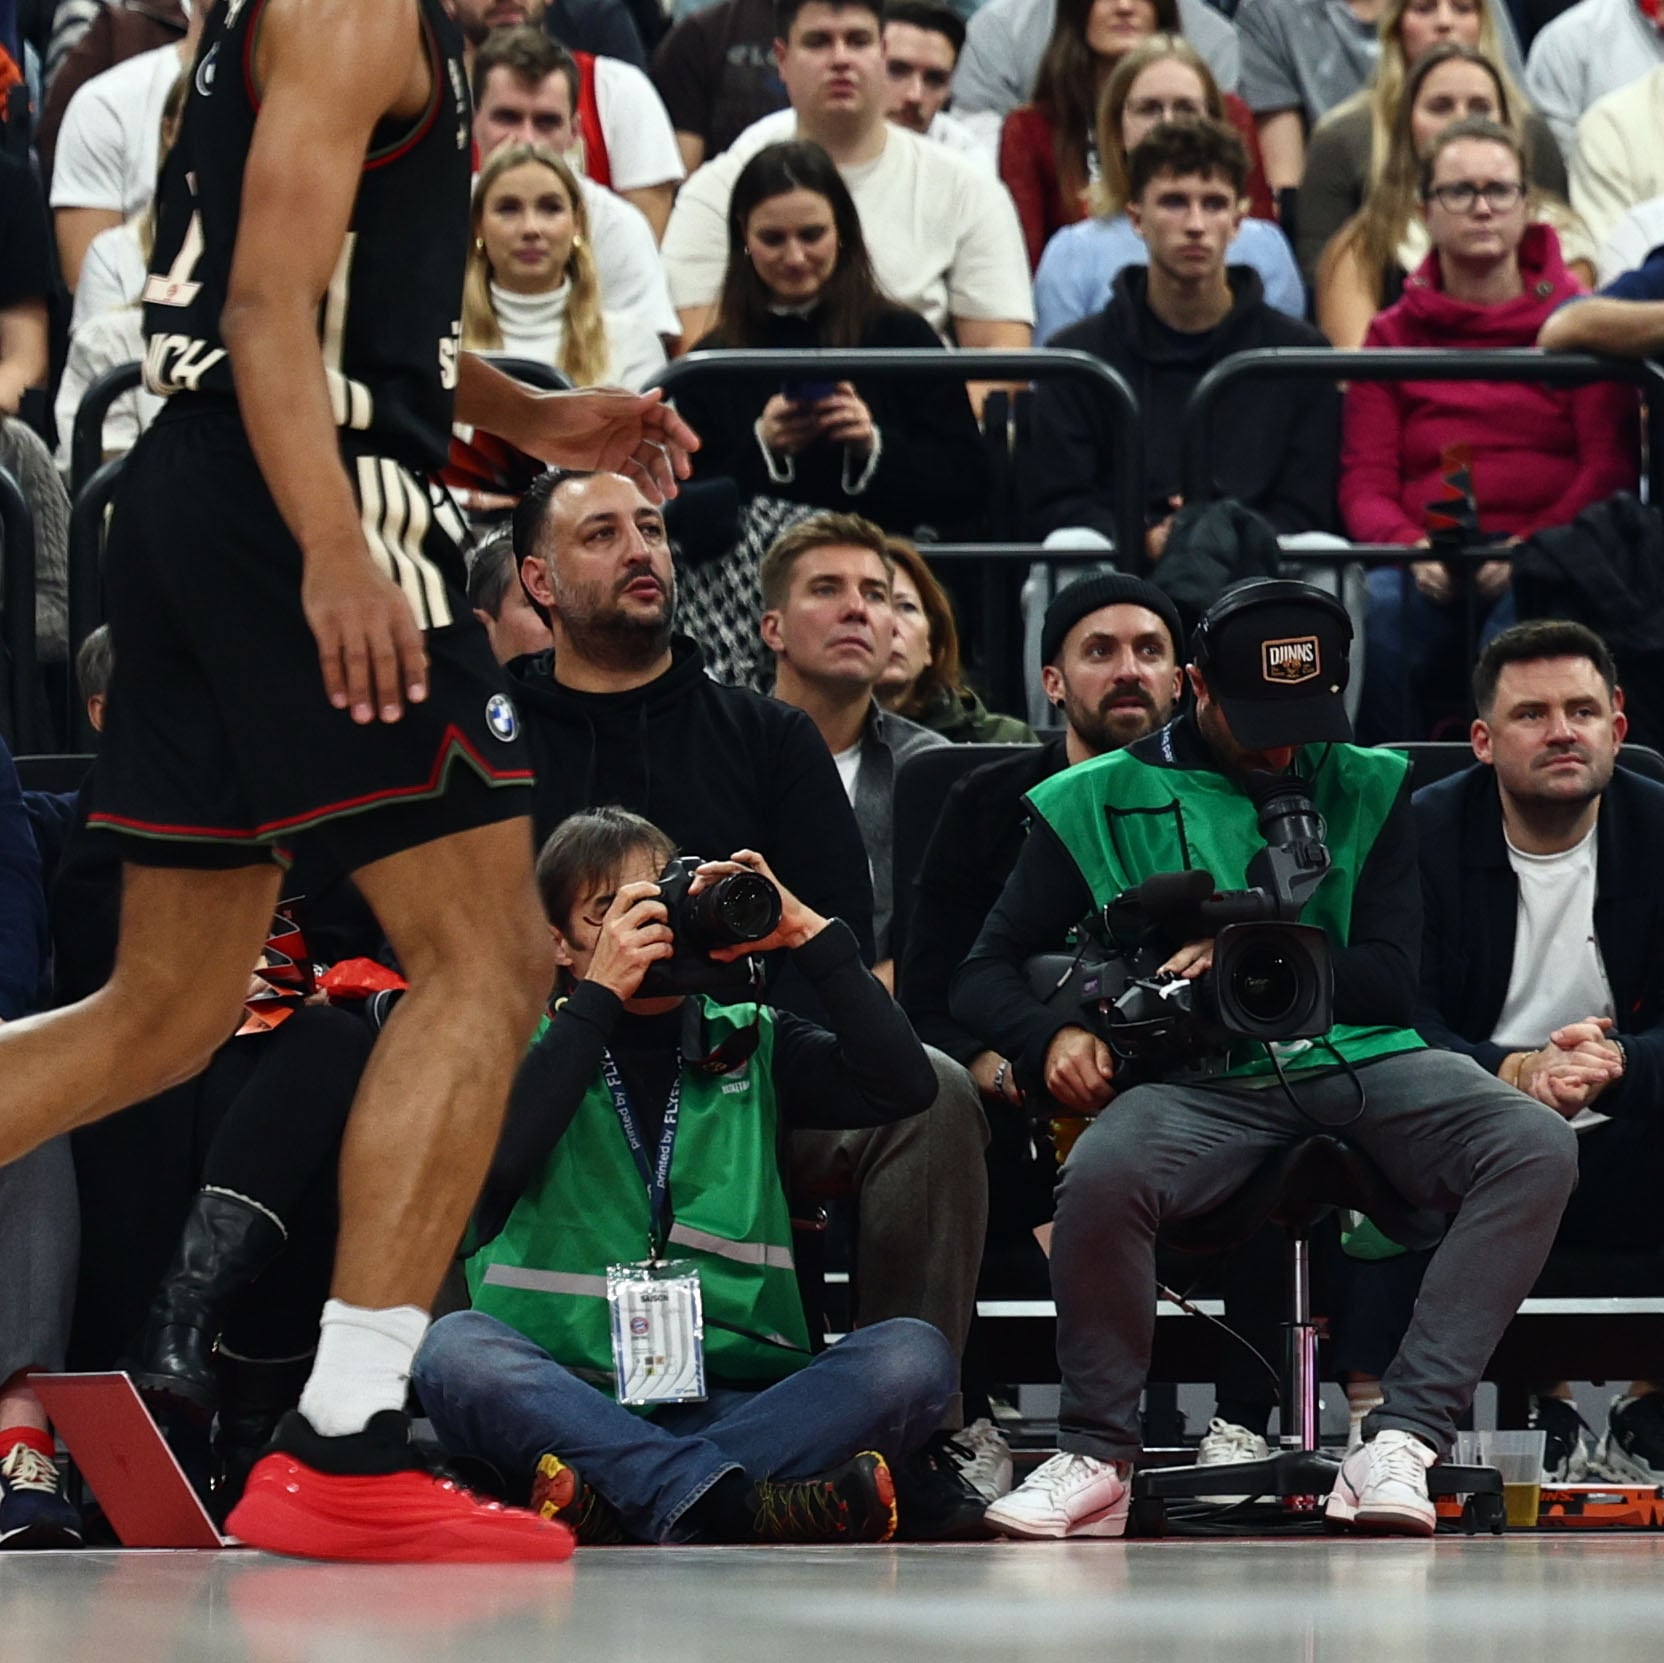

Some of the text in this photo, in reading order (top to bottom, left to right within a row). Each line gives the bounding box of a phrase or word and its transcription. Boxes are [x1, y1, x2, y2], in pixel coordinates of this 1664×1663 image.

[613, 1091, 627, 1107] by
[620, 1107, 641, 1151] printed
[663, 1128, 675, 1143] by
[655, 1142, 672, 1189] printed
